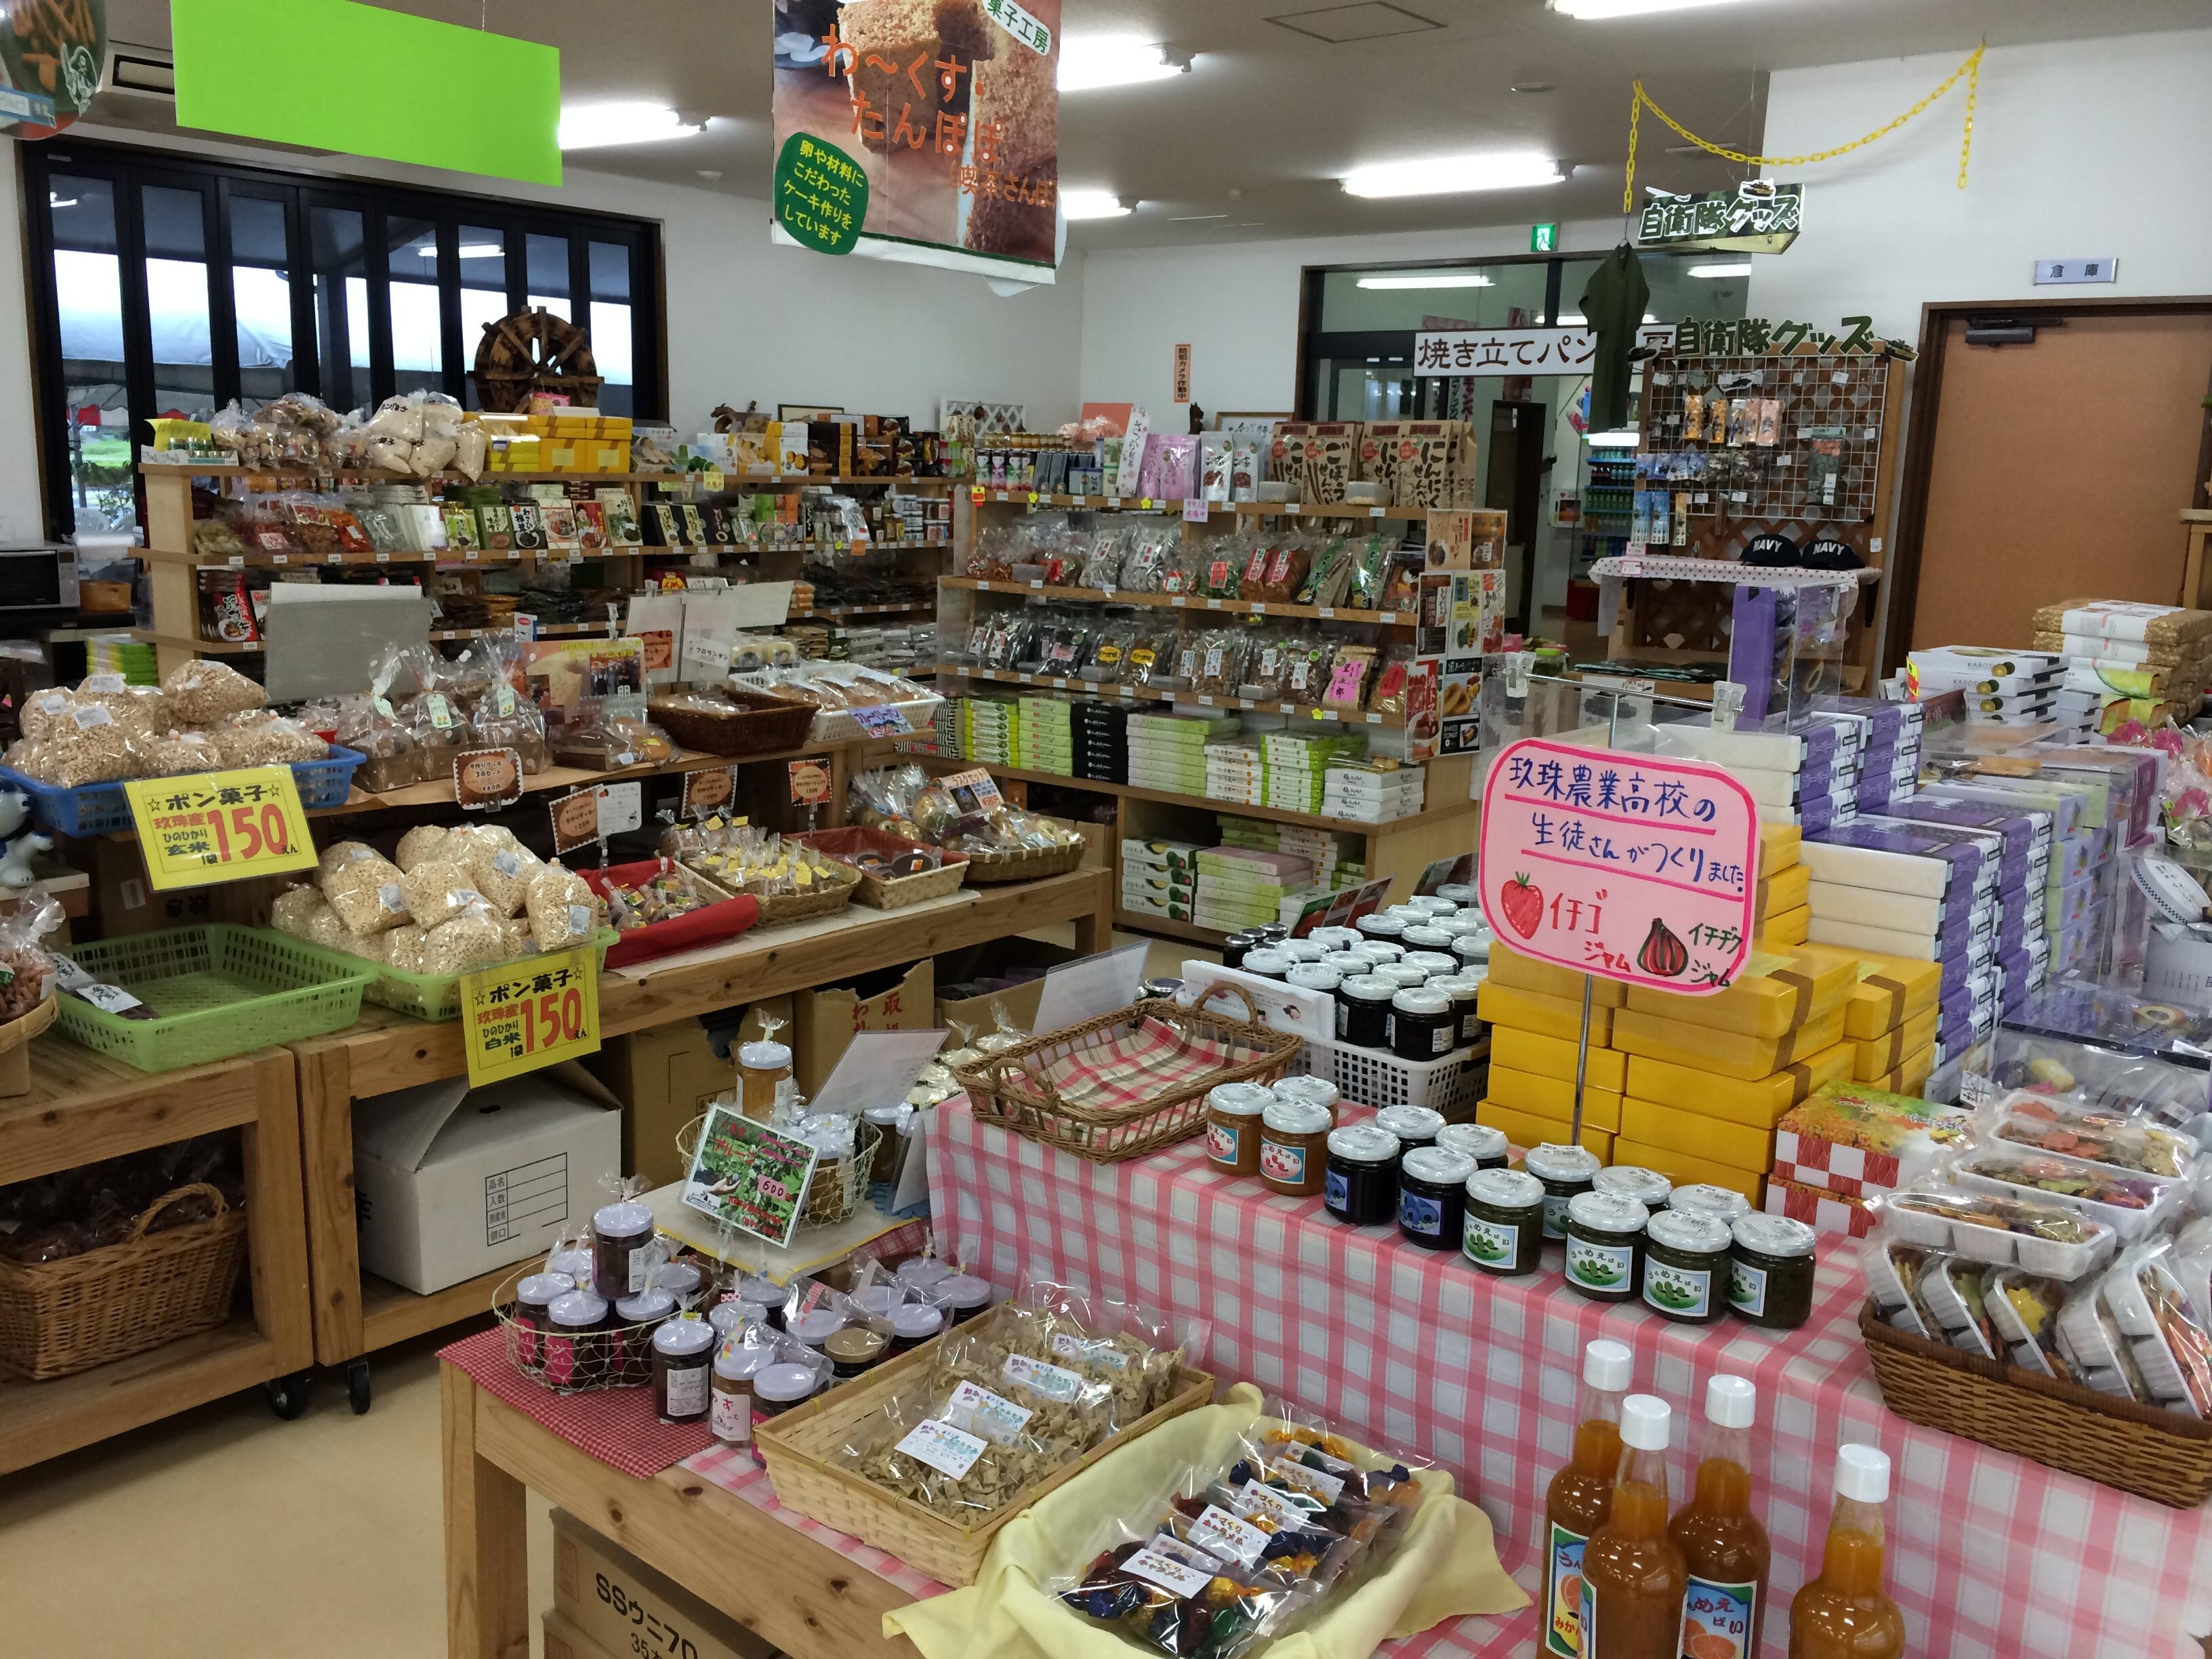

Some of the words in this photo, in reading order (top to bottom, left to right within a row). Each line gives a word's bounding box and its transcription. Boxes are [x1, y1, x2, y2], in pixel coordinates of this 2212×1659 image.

[851, 90, 1002, 163] たんぽぽ
[800, 140, 865, 188] 卵や材料に
[794, 162, 852, 206] こだわった
[783, 180, 853, 230] ケーキ作りを
[1638, 194, 1800, 240] 自衛隊グッズ
[785, 204, 842, 246] しています
[2050, 263, 2099, 278] 倉庫
[1673, 314, 1875, 357] 自衛隊グッズ
[1753, 539, 1782, 553] NAVY
[1812, 541, 1845, 556] NAVY
[165, 784, 268, 812] ポン菓子
[1509, 757, 1716, 823] 玖珠農業高校の
[153, 813, 206, 832] 玖珠産
[162, 827, 208, 844] ひのひかり
[207, 802, 288, 863] 150
[166, 842, 210, 857] 玄米
[1550, 888, 1609, 935] イチゴ
[1584, 941, 1631, 972] ジャム
[489, 968, 573, 1004] ポン菓子
[1690, 959, 1731, 987] ジャム
[476, 1003, 520, 1027] 玖珠産
[482, 1019, 520, 1039] ひのひかり
[519, 987, 583, 1054] 150
[485, 1032, 520, 1051] 白米
[489, 1176, 505, 1190] 品名
[762, 1181, 784, 1197] 600
[489, 1194, 506, 1208] 入数
[1713, 1614, 1744, 1635] ばい
